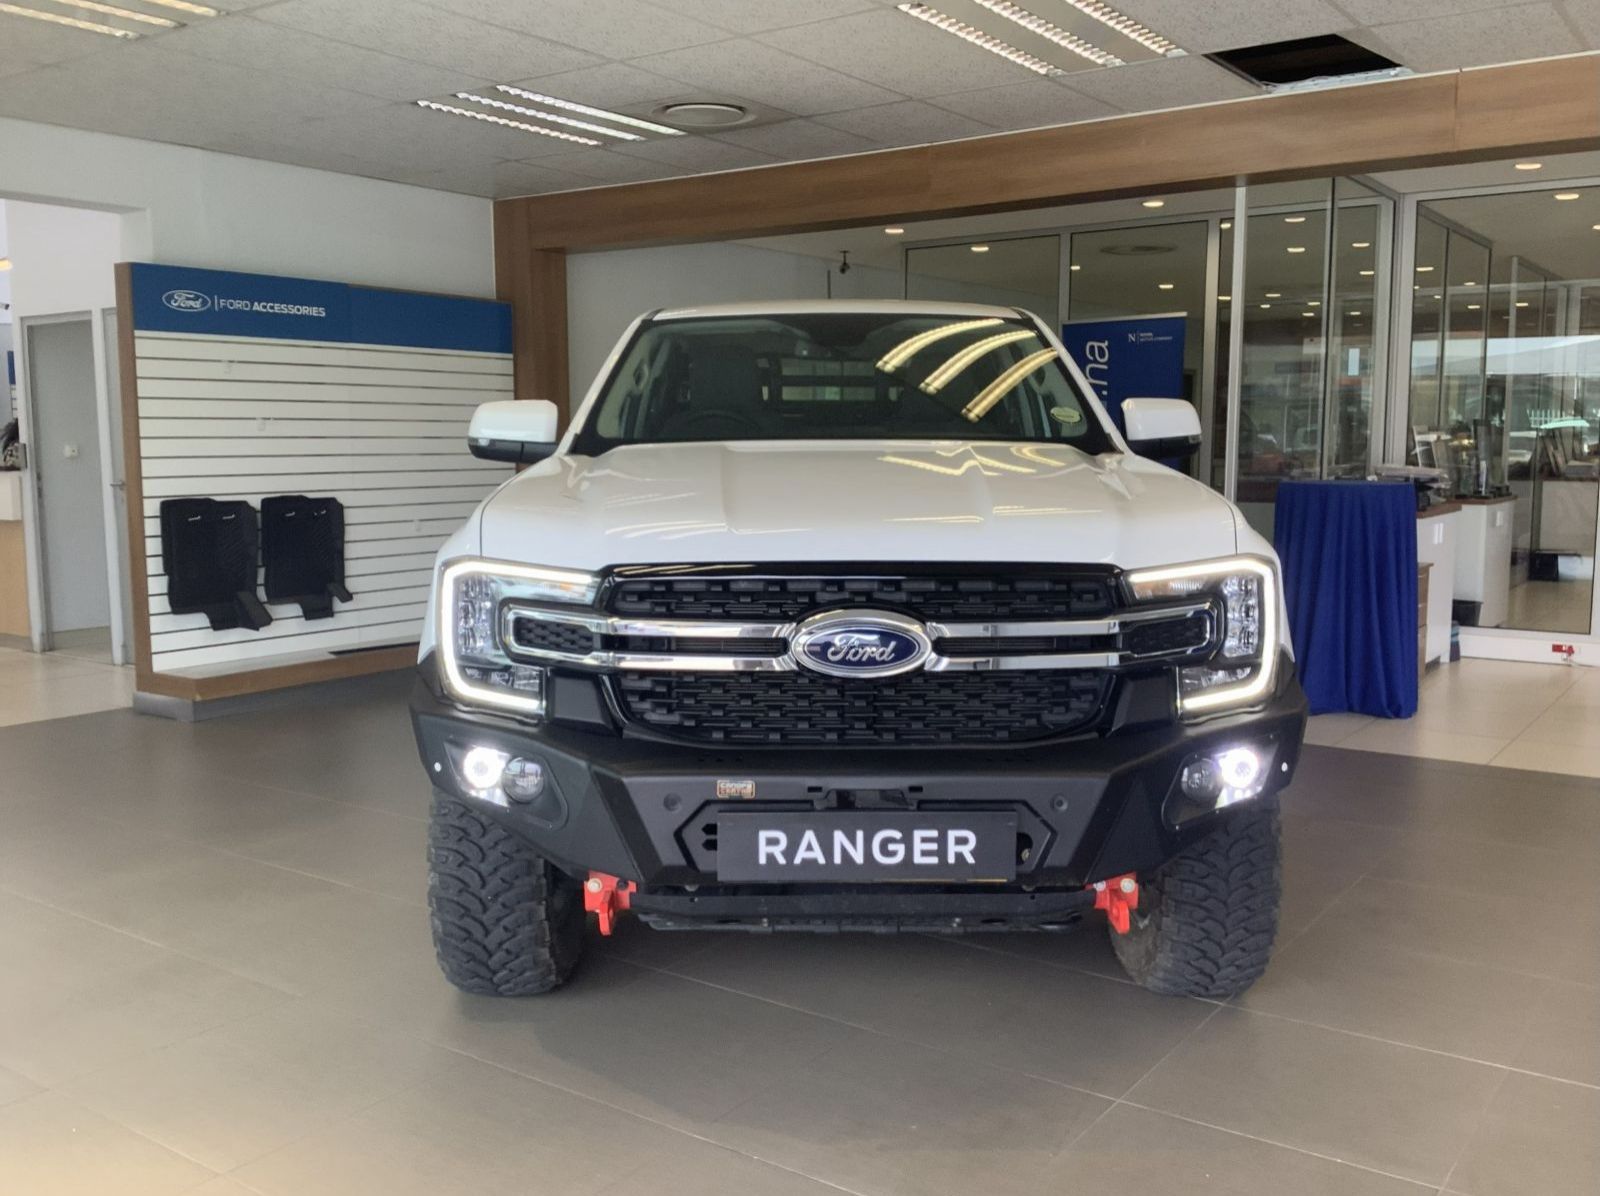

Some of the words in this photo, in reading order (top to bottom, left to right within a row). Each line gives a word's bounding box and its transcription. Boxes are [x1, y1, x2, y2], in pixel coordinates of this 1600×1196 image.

[171, 292, 201, 308] Ford
[220, 299, 250, 310] FORD
[252, 302, 326, 317] ACCESSORIES
[1128, 333, 1136, 342] N
[1085, 340, 1109, 409] .na
[827, 632, 897, 662] Ford
[758, 829, 977, 865] RANGER
